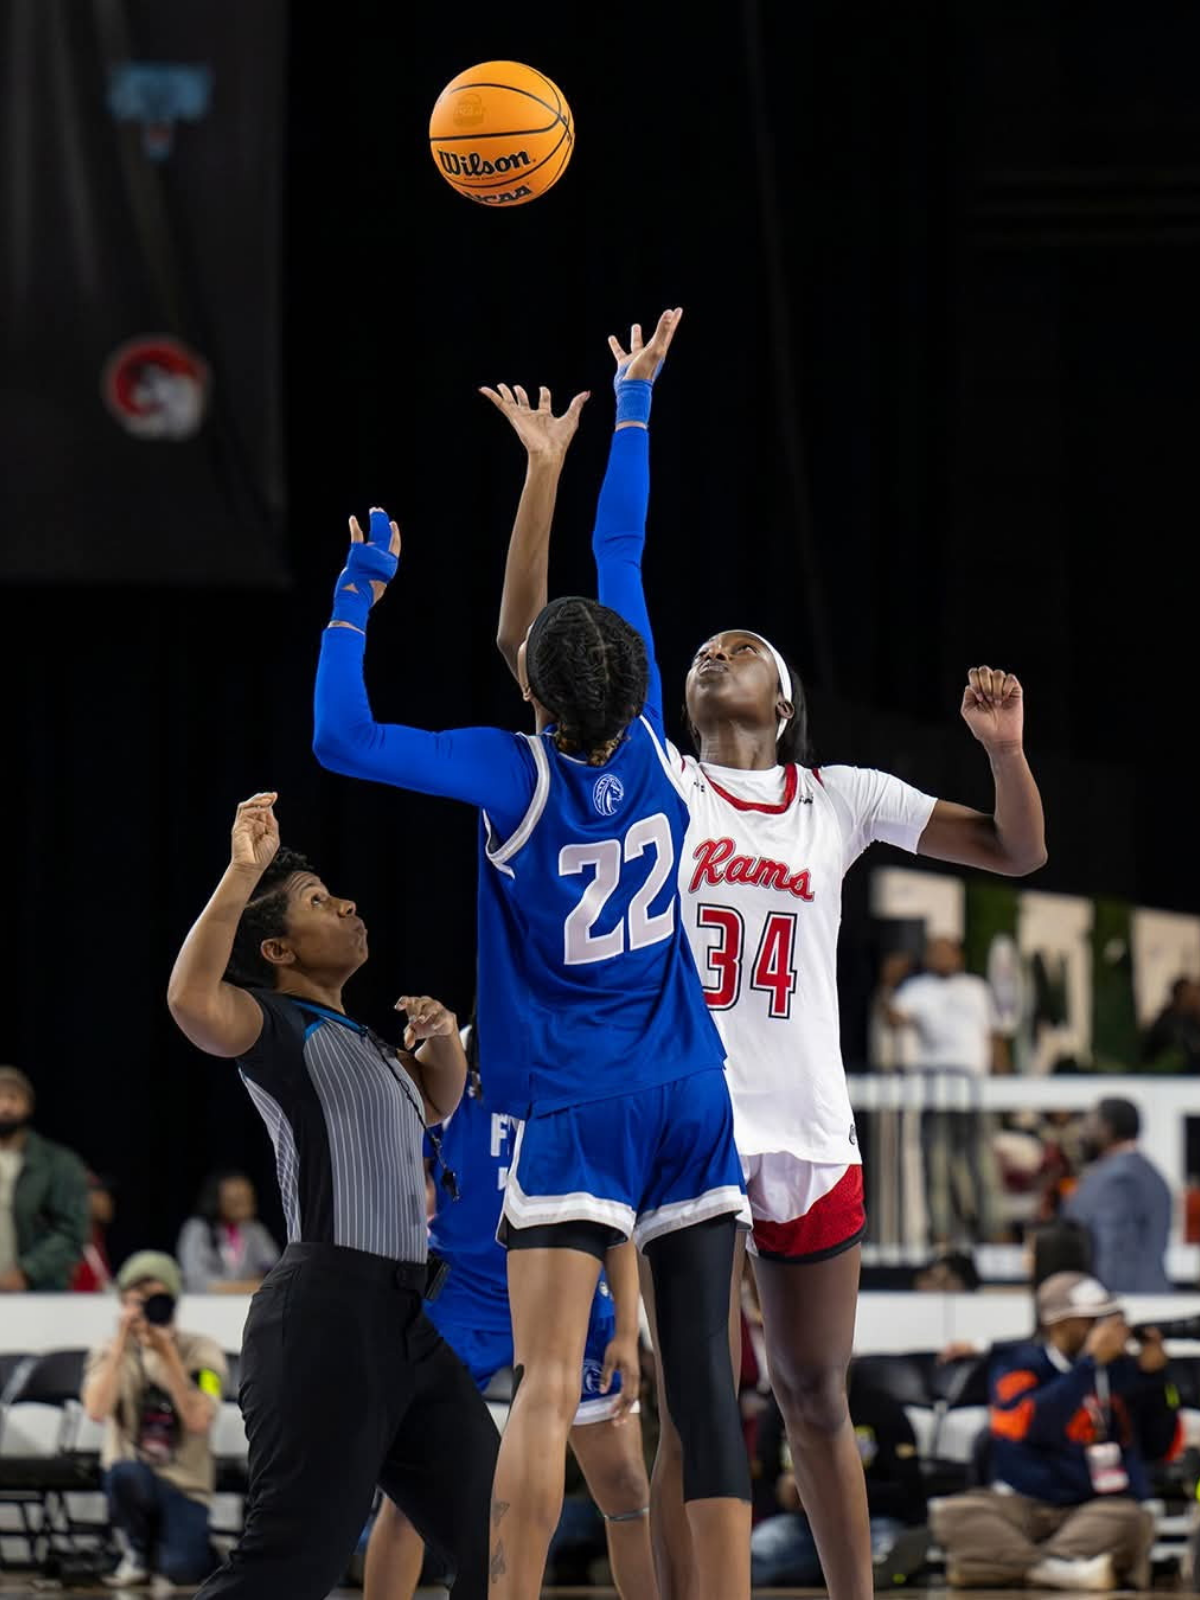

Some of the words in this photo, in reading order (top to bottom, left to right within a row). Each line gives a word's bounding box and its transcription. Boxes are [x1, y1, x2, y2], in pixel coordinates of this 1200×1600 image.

[437, 150, 530, 176] Wilson
[558, 812, 675, 965] 22
[689, 837, 815, 902] Rams
[697, 902, 797, 1019] 34
